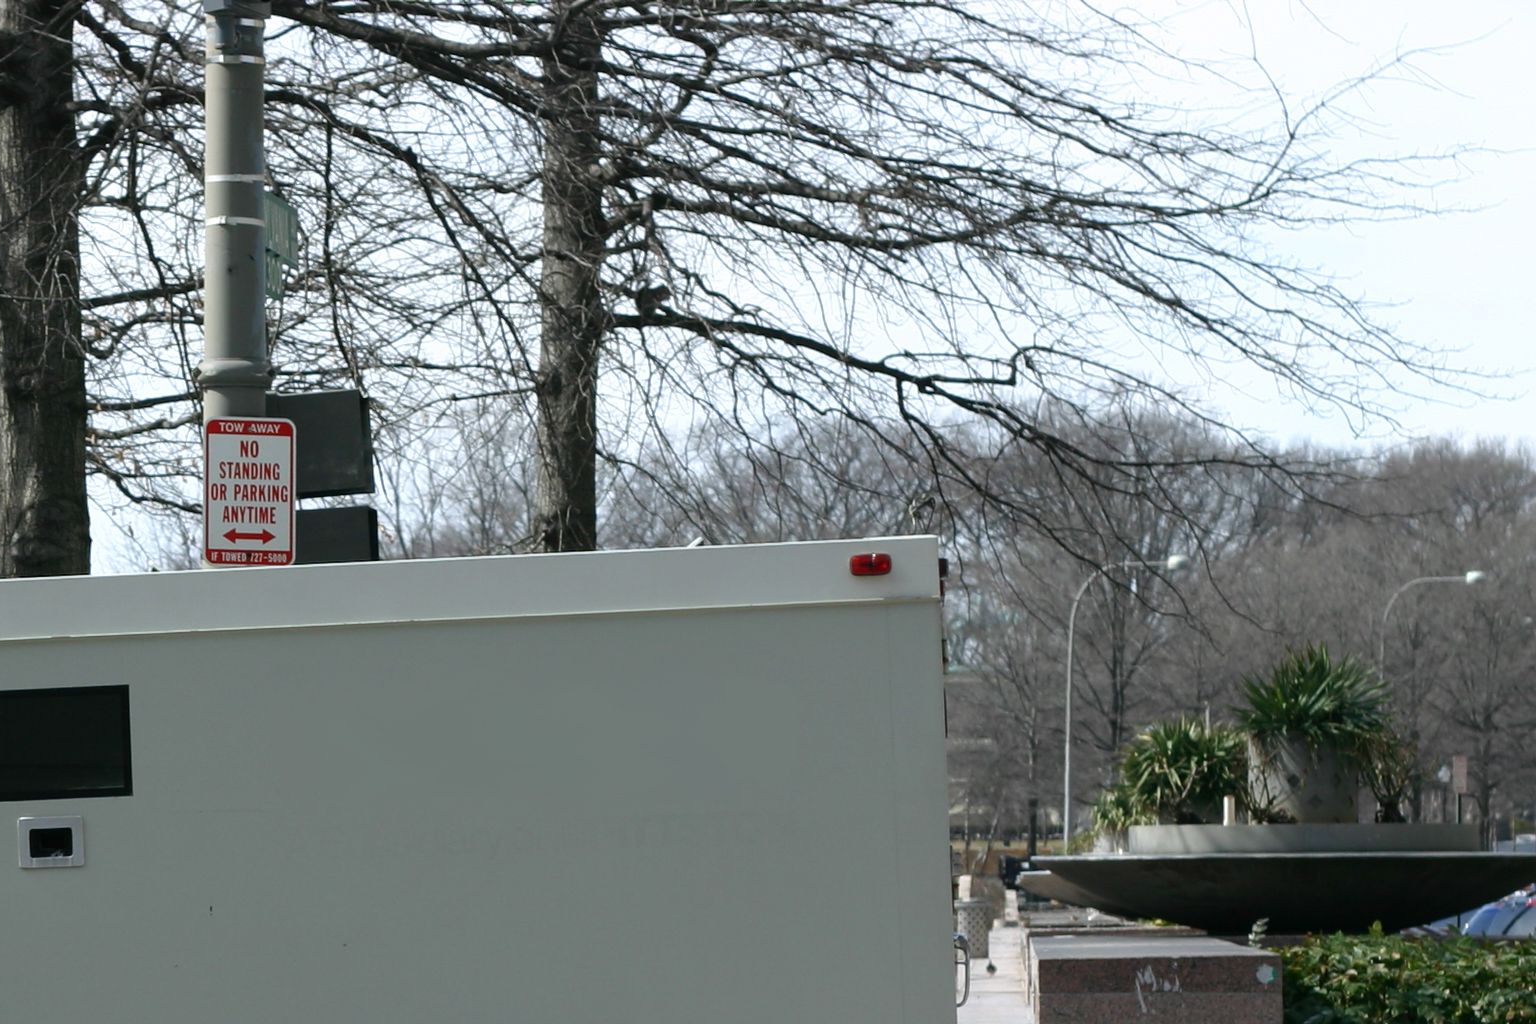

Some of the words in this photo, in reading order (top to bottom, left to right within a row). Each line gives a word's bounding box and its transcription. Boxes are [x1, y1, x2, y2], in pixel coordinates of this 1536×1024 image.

[219, 422, 244, 433] TOW
[248, 424, 280, 434] AWAY
[240, 440, 259, 457] NO
[219, 461, 280, 480] STANDING
[211, 483, 227, 500] OR
[234, 484, 288, 502] PARKING
[222, 505, 276, 524] ANYTIME
[211, 551, 218, 561] IF
[221, 552, 247, 562] TOWED
